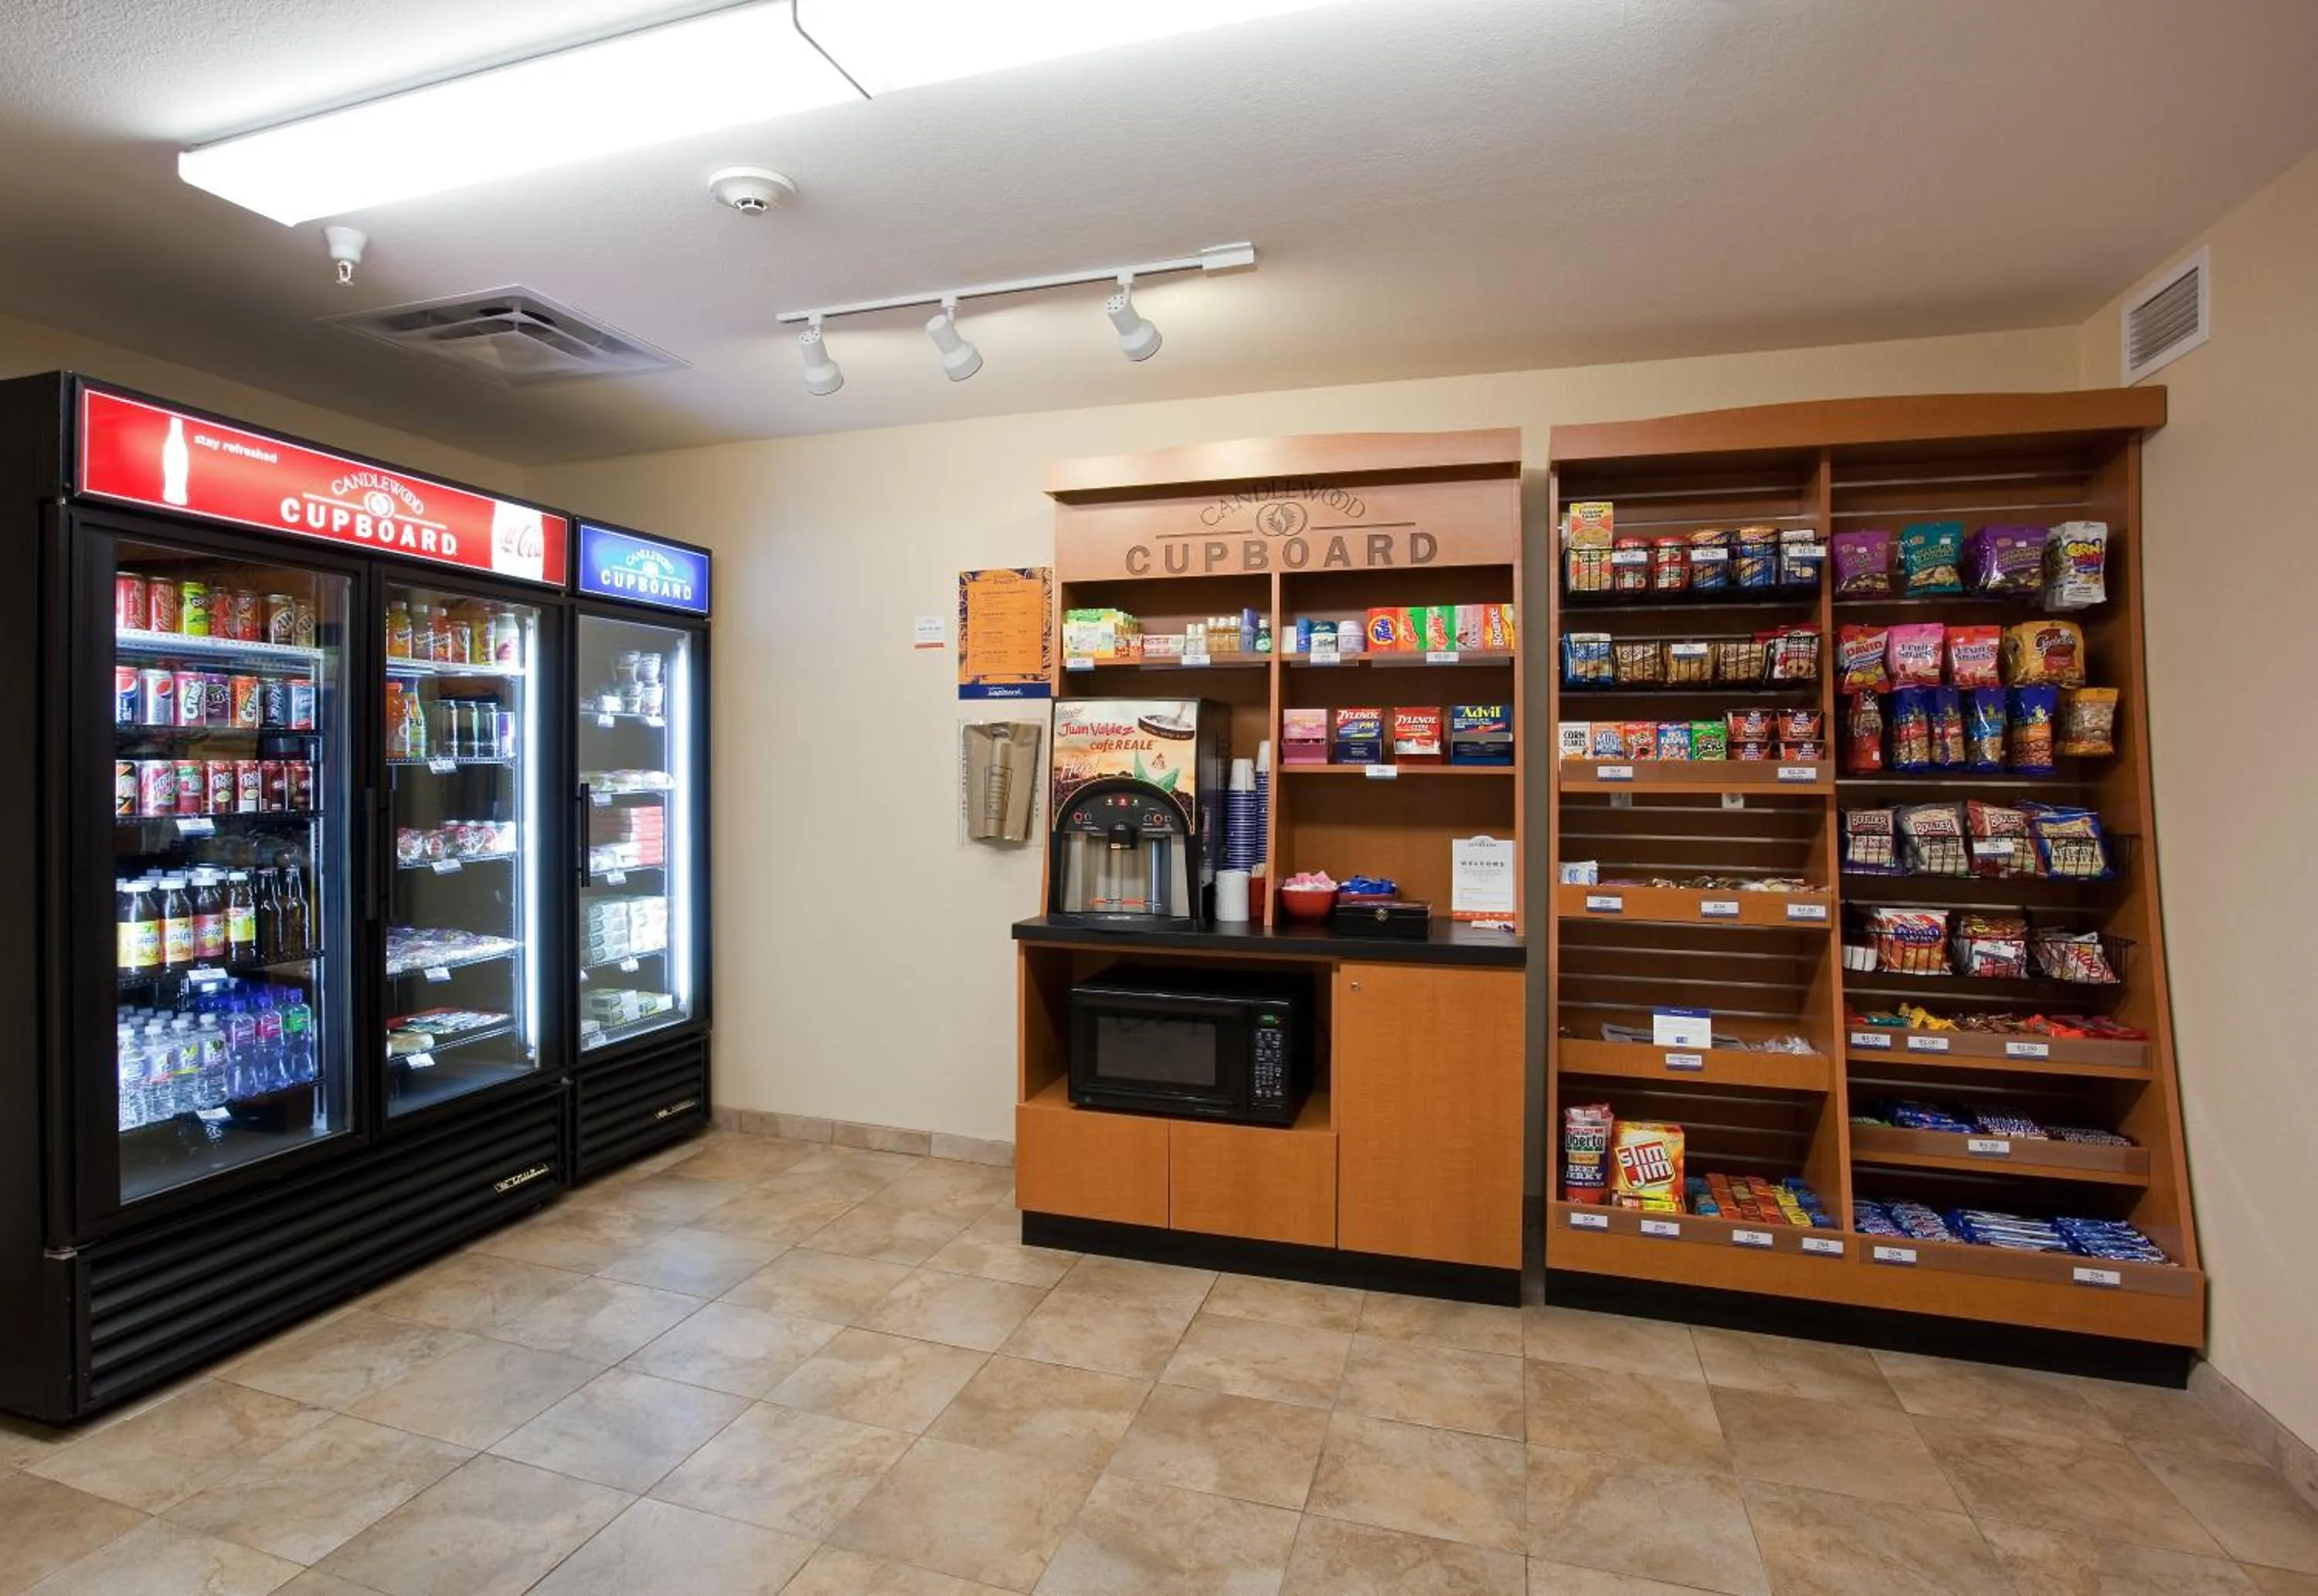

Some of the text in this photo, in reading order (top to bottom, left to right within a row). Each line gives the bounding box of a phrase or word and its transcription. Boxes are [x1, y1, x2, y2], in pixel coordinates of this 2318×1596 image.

[195, 435, 278, 464] stay refreshed
[331, 472, 425, 515] CANDLEWOOD
[1200, 483, 1366, 526] CANDLEWOOD
[280, 497, 458, 556] CUPBOARD
[1125, 531, 1439, 576] CUPBOARD
[600, 568, 693, 601] CUPBOARD
[1846, 640, 1884, 657] DAVID
[1337, 709, 1379, 722] TYLENOL
[1461, 706, 1501, 718] Advil
[1395, 715, 1437, 728] TYLENOL
[1059, 722, 1135, 736] Juan Valdez
[1563, 730, 1585, 739] CORN
[1852, 814, 1888, 828] BOULDER
[1916, 820, 1954, 834] BOULDER
[1566, 1133, 1603, 1147] Oberto
